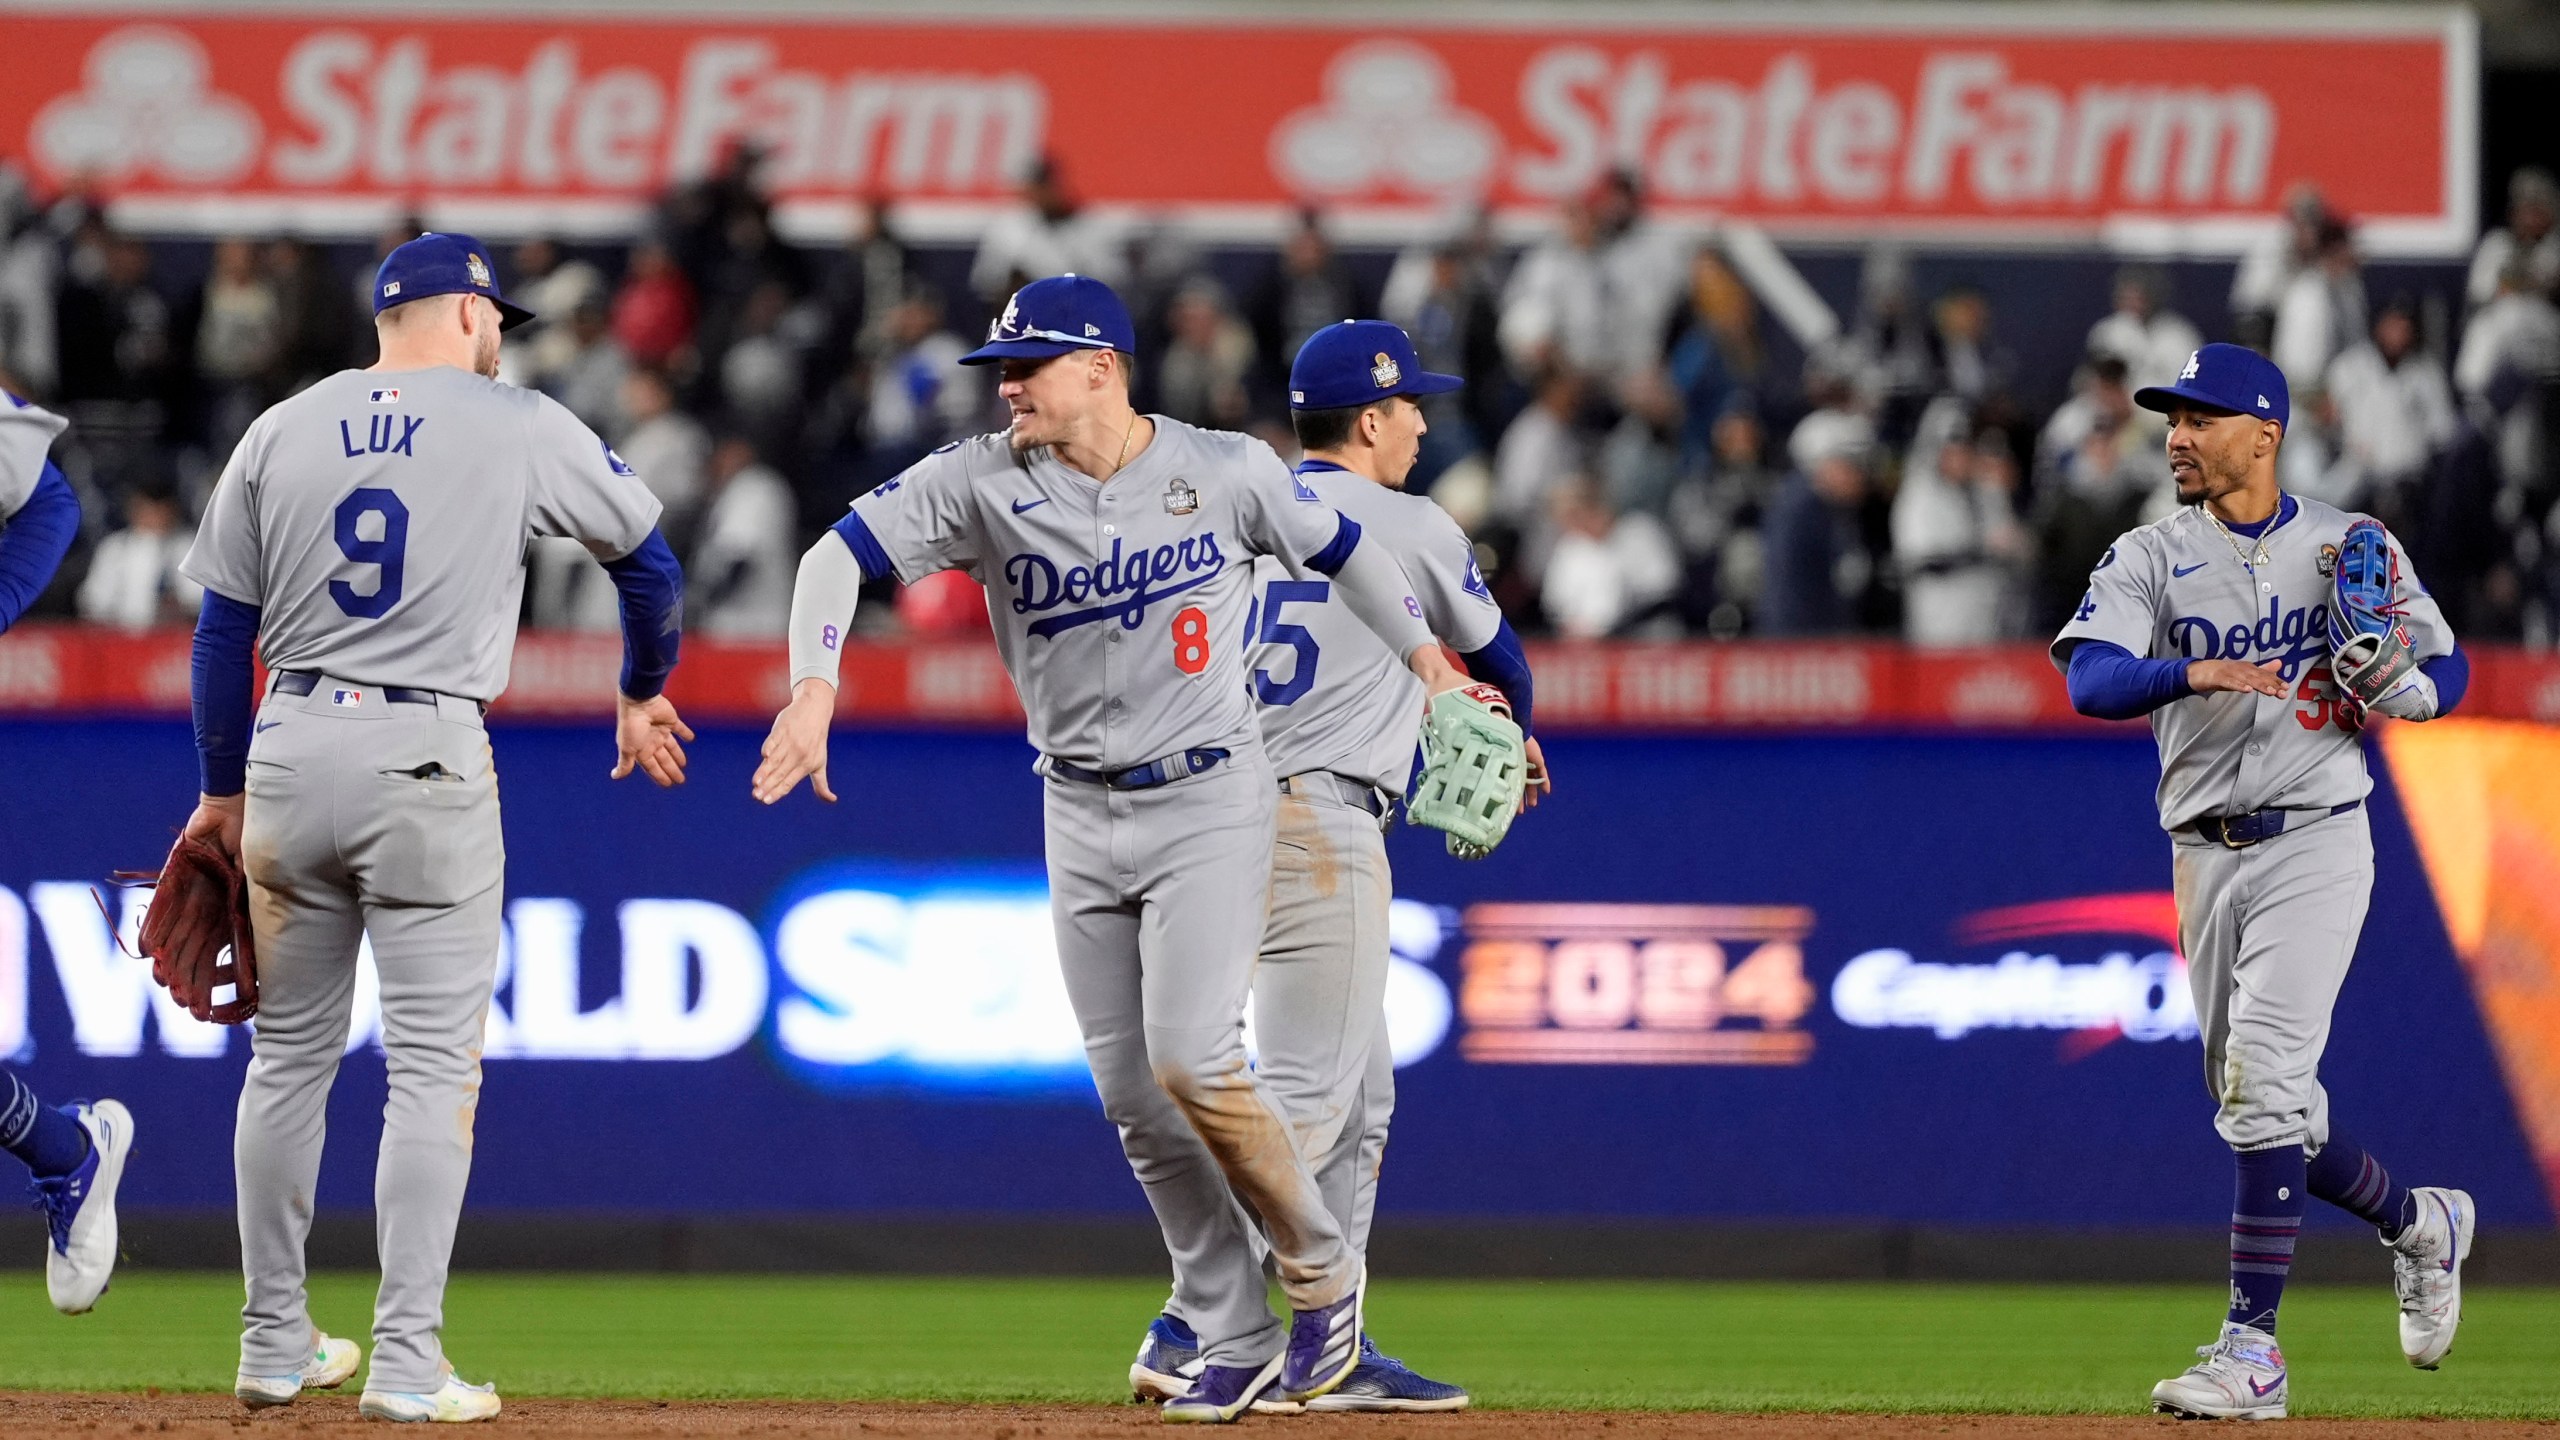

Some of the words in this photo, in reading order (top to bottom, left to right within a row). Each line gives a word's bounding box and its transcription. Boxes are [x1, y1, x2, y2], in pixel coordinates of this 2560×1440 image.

[340, 414, 425, 458] LUX
[1166, 491, 1196, 502] WORLD
[1167, 499, 1196, 509] SERIES
[328, 487, 410, 620] 9
[1004, 531, 1226, 642] Dodgers
[1403, 595, 1423, 620] 8
[822, 623, 839, 651] 8
[1171, 606, 1211, 676] 8
[1243, 580, 1331, 707] 5
[2167, 594, 2330, 685] Dodge
[2363, 650, 2402, 689] Wilson
[1193, 755, 1204, 767] 8
[27, 879, 770, 1060] WLD
[2229, 1278, 2251, 1312] LA
